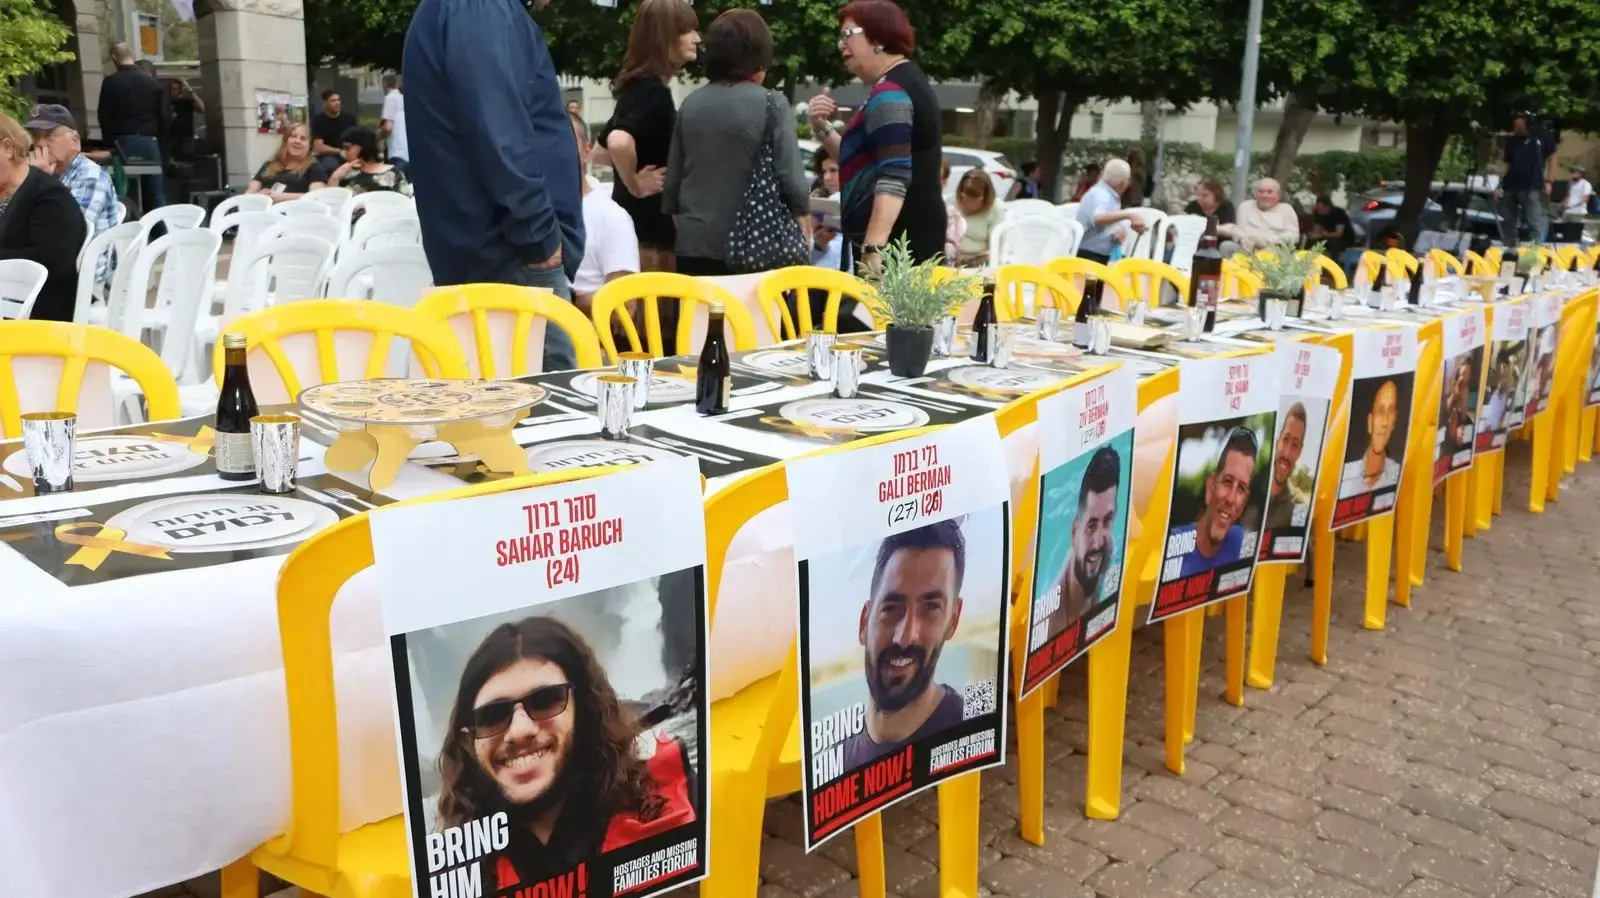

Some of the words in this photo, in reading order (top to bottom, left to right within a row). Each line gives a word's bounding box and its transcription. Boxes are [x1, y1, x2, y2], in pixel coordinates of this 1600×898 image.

[831, 408, 896, 423] לכולם
[1089, 400, 1109, 424] BERMAN
[75, 444, 160, 460] כולם
[543, 452, 603, 467] חירות
[893, 449, 918, 477] ברמן
[921, 445, 938, 466] גלי
[879, 477, 904, 503] GALI
[907, 465, 951, 495] BERMAN
[149, 508, 238, 528] חירות
[242, 504, 280, 512] חג
[522, 500, 560, 533] ברוך
[564, 494, 597, 523] סהר
[888, 499, 918, 527] (27)
[163, 512, 295, 540] לכולם
[496, 532, 555, 567] SAHAR
[559, 518, 623, 555] BARUCH
[1166, 530, 1197, 558] BRING
[546, 554, 580, 589] (24)
[1163, 556, 1184, 583] HIM
[1033, 584, 1062, 626] BRING
[1031, 619, 1050, 653] HIM
[812, 702, 865, 755] BRING
[931, 740, 958, 758] HOSTAGES
[959, 735, 970, 747] AND
[970, 728, 995, 743] MISSING
[813, 743, 844, 790] HIM
[930, 748, 965, 772] FAMILIES
[966, 739, 995, 759] FORUM
[814, 773, 859, 826] HOME
[864, 745, 912, 797] NOW!
[425, 811, 510, 873] BRING
[614, 855, 650, 877] HOSTAGES
[651, 849, 665, 862] AND
[667, 838, 697, 858] MISSING
[430, 861, 482, 898] HIM
[515, 862, 586, 898] W!
[614, 863, 660, 893] FAMILIES
[661, 849, 697, 877] FORUM
